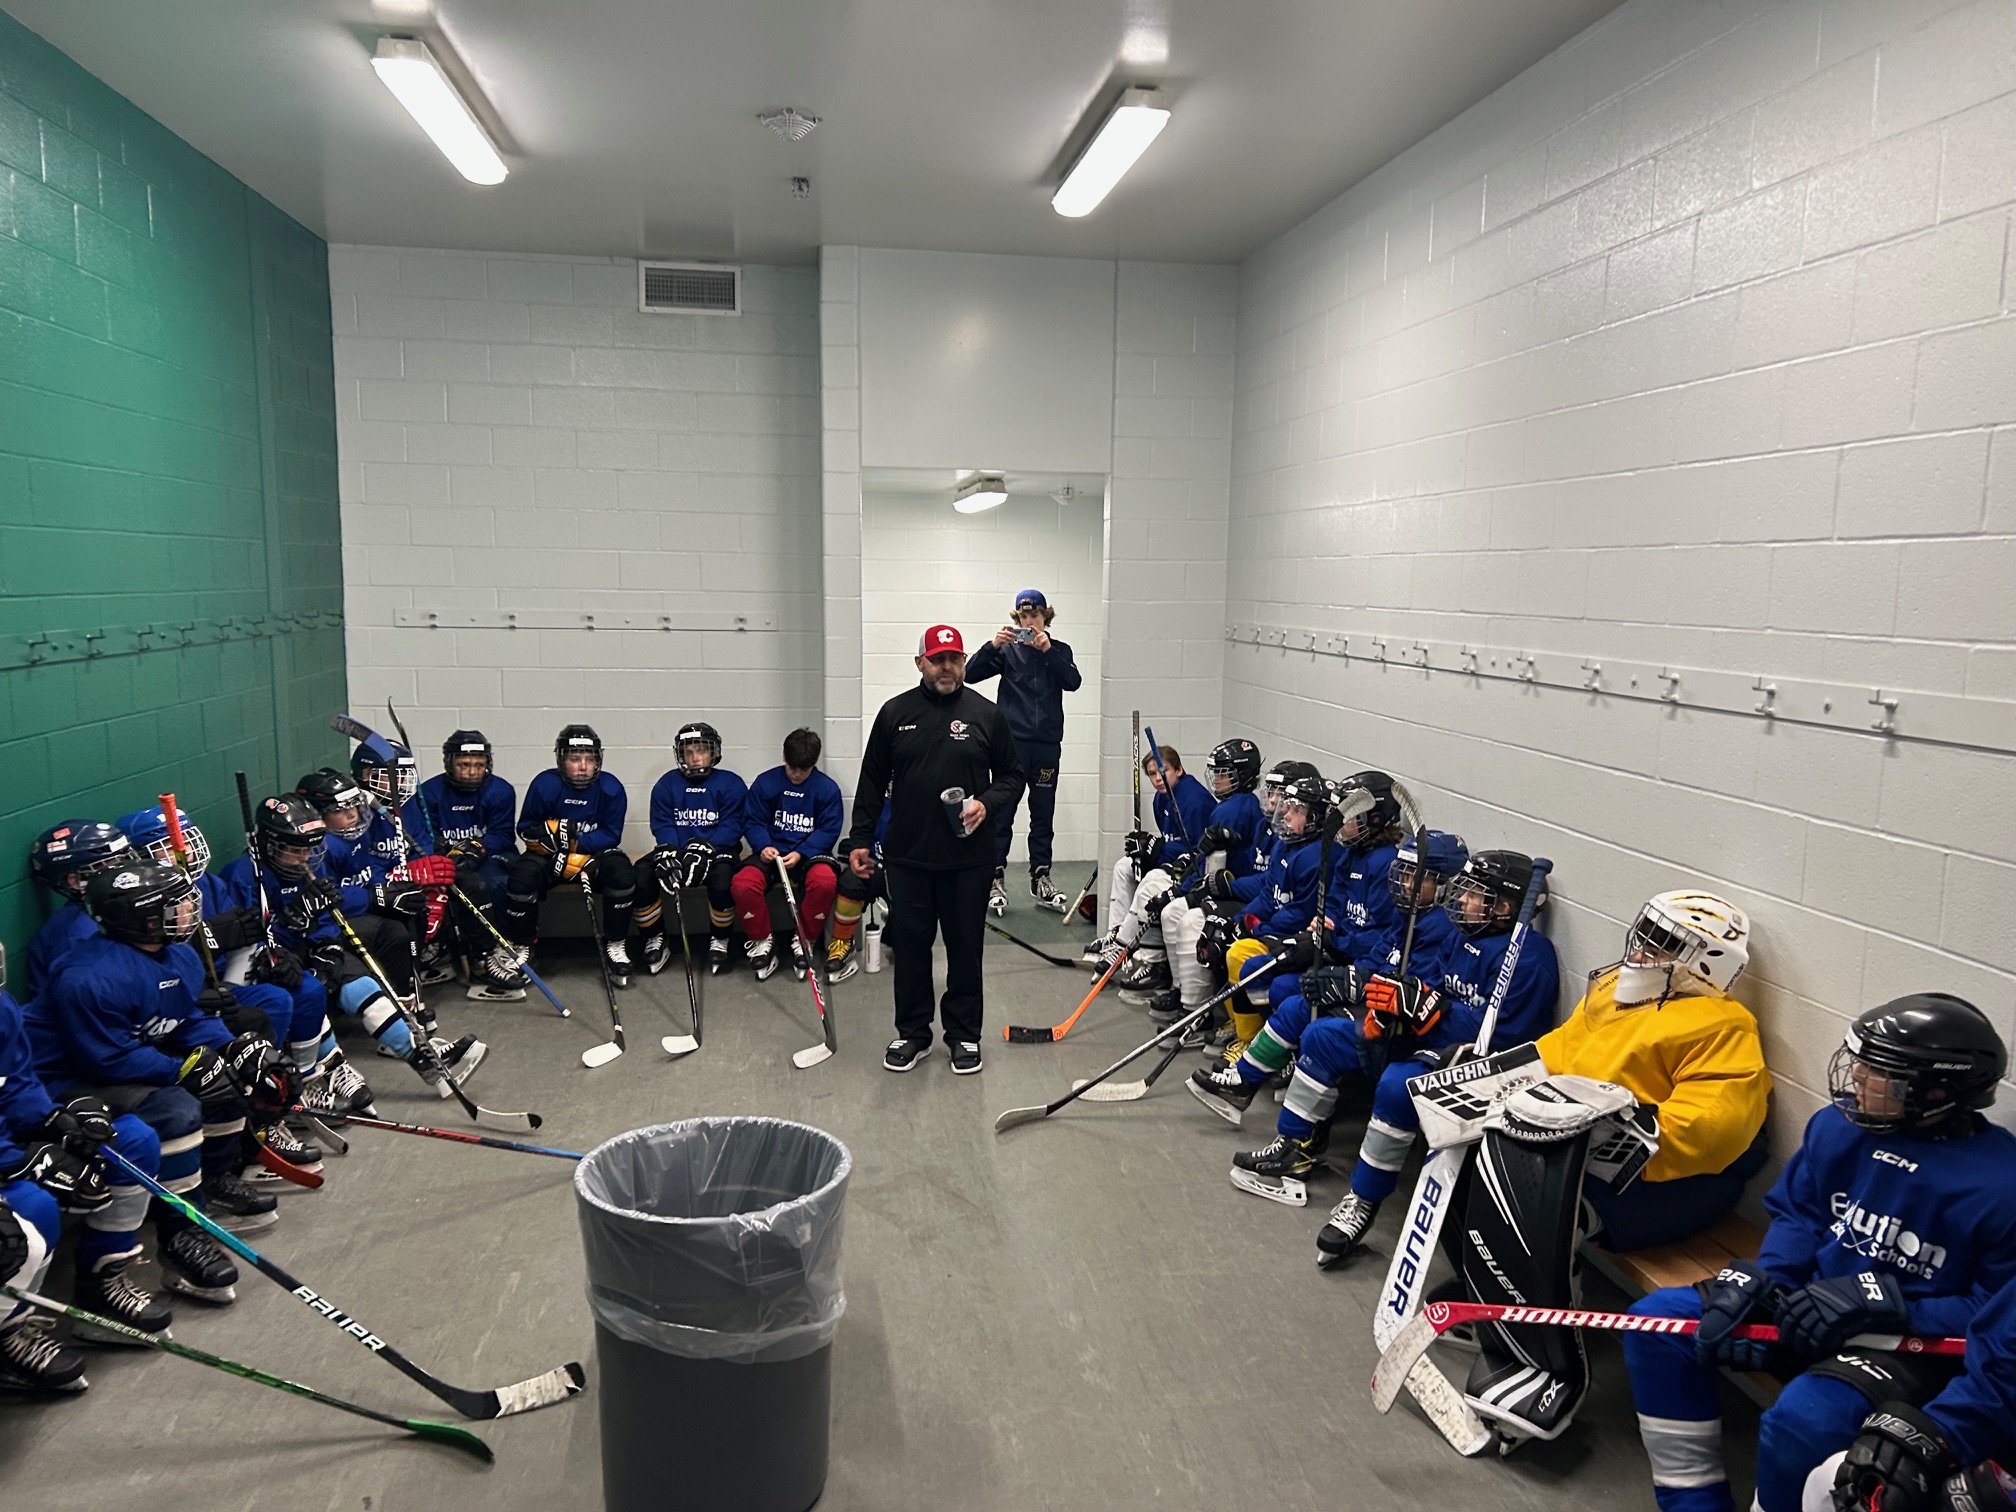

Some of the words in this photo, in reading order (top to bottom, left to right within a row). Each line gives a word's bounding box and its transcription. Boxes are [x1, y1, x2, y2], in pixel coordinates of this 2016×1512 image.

[564, 798, 588, 806] CCM
[783, 790, 805, 798] CCM
[1502, 881, 1521, 891] CCM
[1933, 1062, 1973, 1071] BAUER
[1414, 1060, 1492, 1093] VAUGHN
[1872, 1149, 1919, 1173] CCM
[1868, 1241, 1935, 1281] Schools
[1500, 1307, 1687, 1334] WARRIOR
